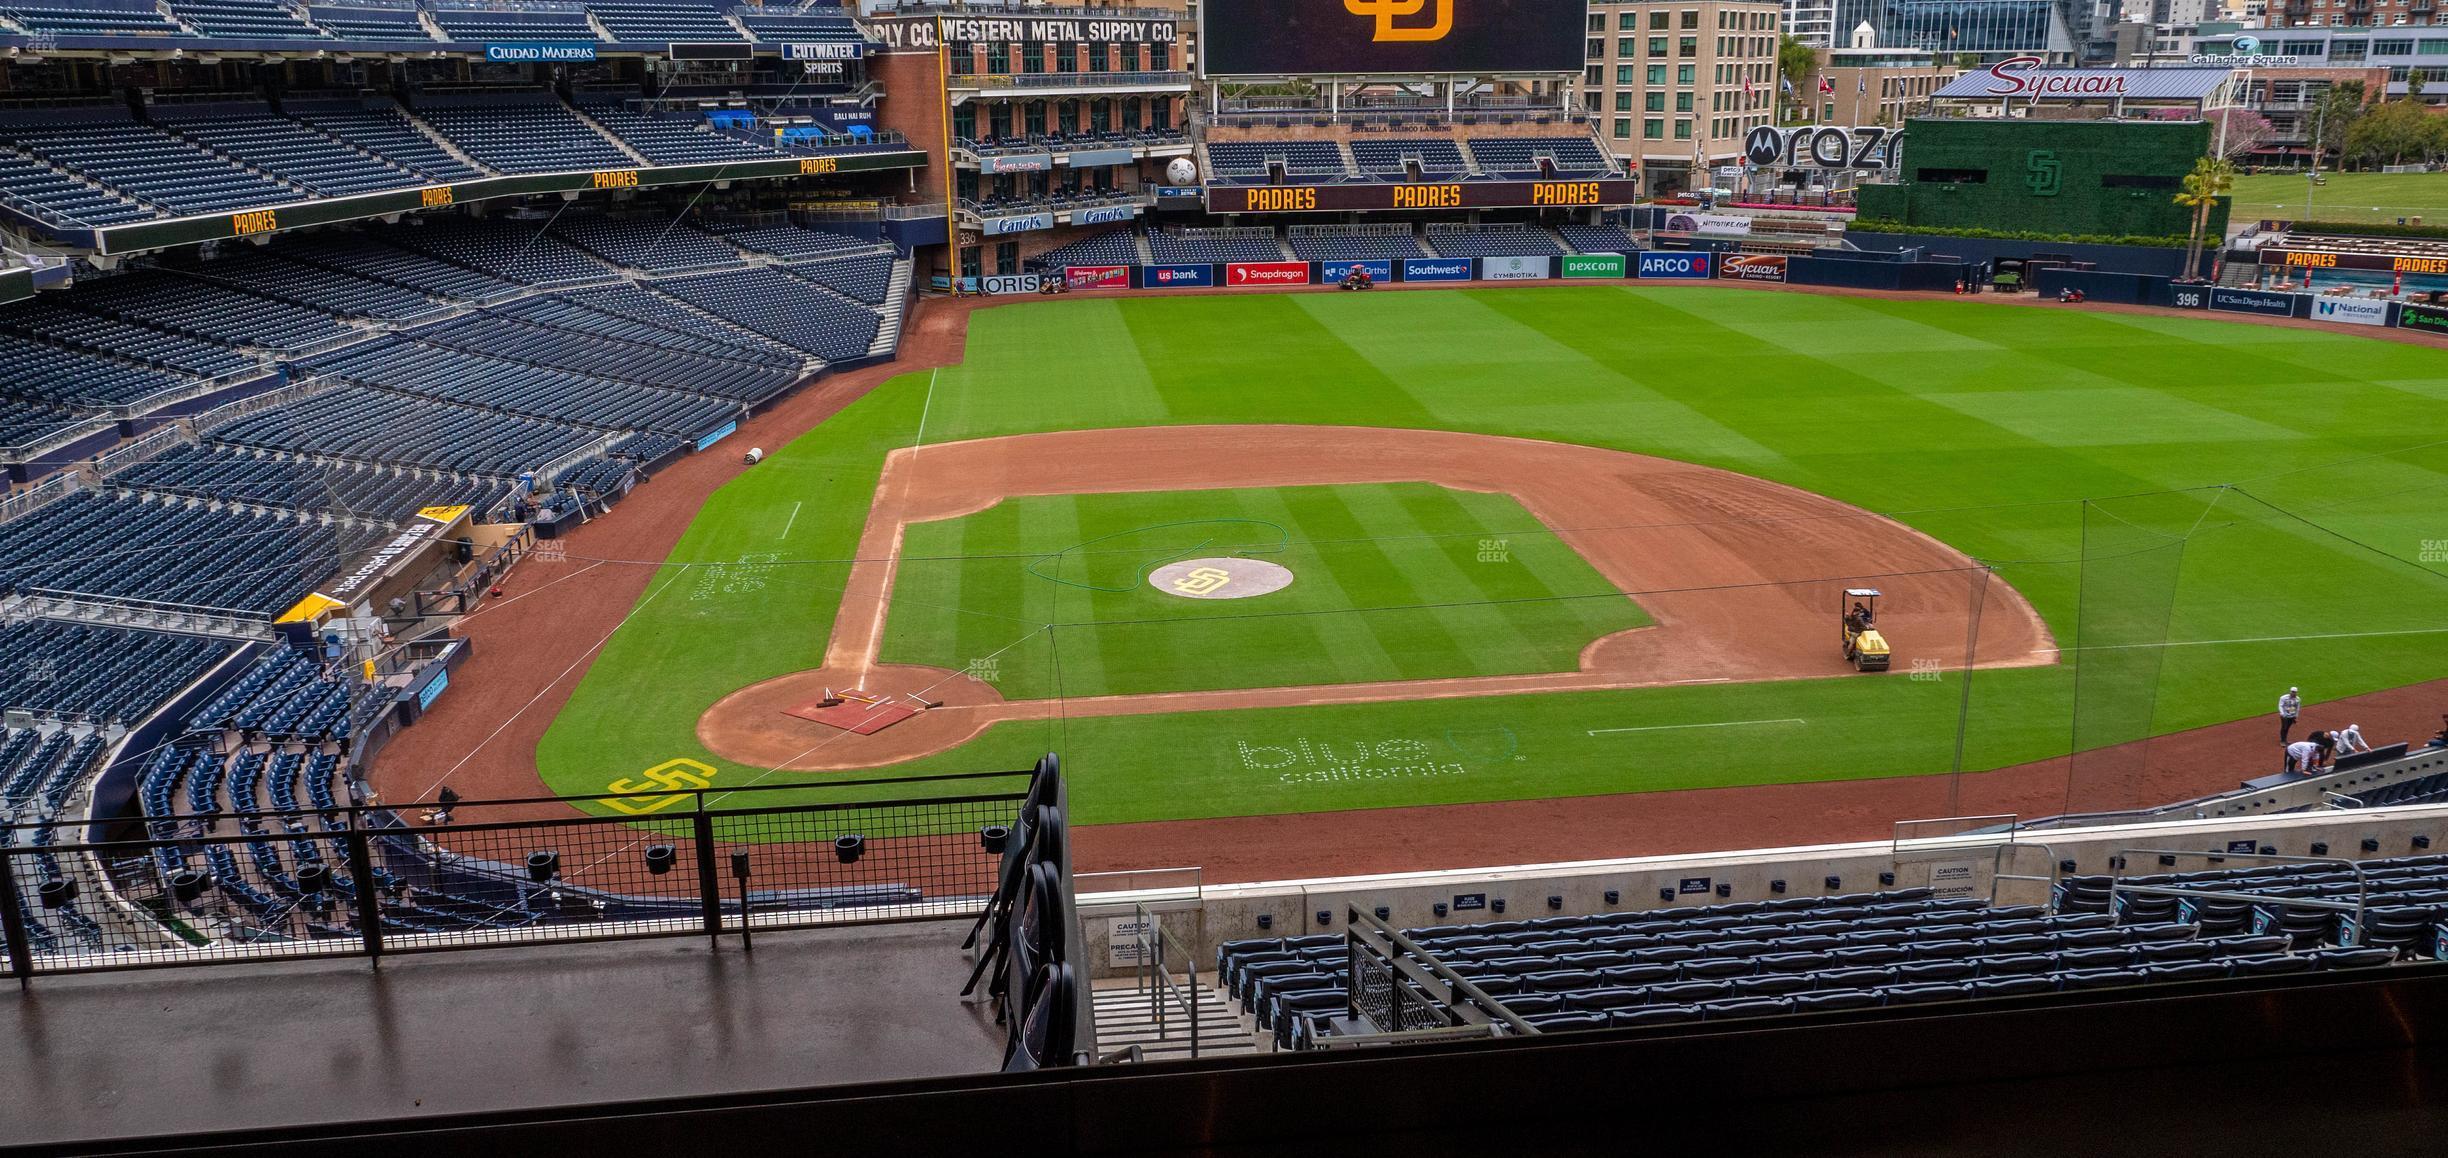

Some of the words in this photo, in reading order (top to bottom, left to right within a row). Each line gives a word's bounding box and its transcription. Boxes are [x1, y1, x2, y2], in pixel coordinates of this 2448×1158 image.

[910, 22, 938, 46] CO.
[941, 20, 1022, 40] WESTERN
[1032, 21, 1084, 41] METAL
[1089, 23, 1146, 42] SUPPLY
[1153, 23, 1176, 41] CO.
[490, 46, 539, 59] CIUDAD
[542, 46, 594, 58] MADERAS
[792, 44, 854, 58] CUTWATER
[2192, 54, 2251, 66] Gallagher
[2252, 54, 2297, 66] Square
[805, 63, 843, 74] SPIRITS
[1987, 56, 2129, 105] Sycuan
[800, 158, 836, 174] PADRES
[594, 171, 638, 188] PADRES
[422, 187, 453, 207] PADRES
[1248, 188, 1316, 210] PADRES
[1394, 185, 1460, 207] PADRES
[1533, 183, 1599, 204] PADRES
[232, 210, 276, 234] PADRES
[998, 215, 1041, 232] Canel's
[1084, 207, 1124, 224] Canel's
[960, 232, 976, 244] 336
[1642, 259, 1690, 272] ARCO
[1724, 256, 1780, 278] Sycuan
[2286, 252, 2337, 267] PADRES
[2394, 258, 2448, 272] PADRES
[1158, 272, 1170, 280] us
[1173, 270, 1198, 280] bank
[1250, 270, 1304, 280] Snapdragon
[1338, 267, 1387, 276] QuilOrtho
[1409, 265, 1460, 274] Southwest
[986, 276, 1037, 293] ORIS
[2176, 293, 2200, 306] 396
[2218, 295, 2228, 303] UC
[2229, 296, 2242, 304] San
[2243, 297, 2262, 308] Diego
[2264, 298, 2286, 308] Health
[2338, 303, 2382, 314] National
[1238, 738, 1428, 770] blue
[1280, 762, 1464, 783] california
